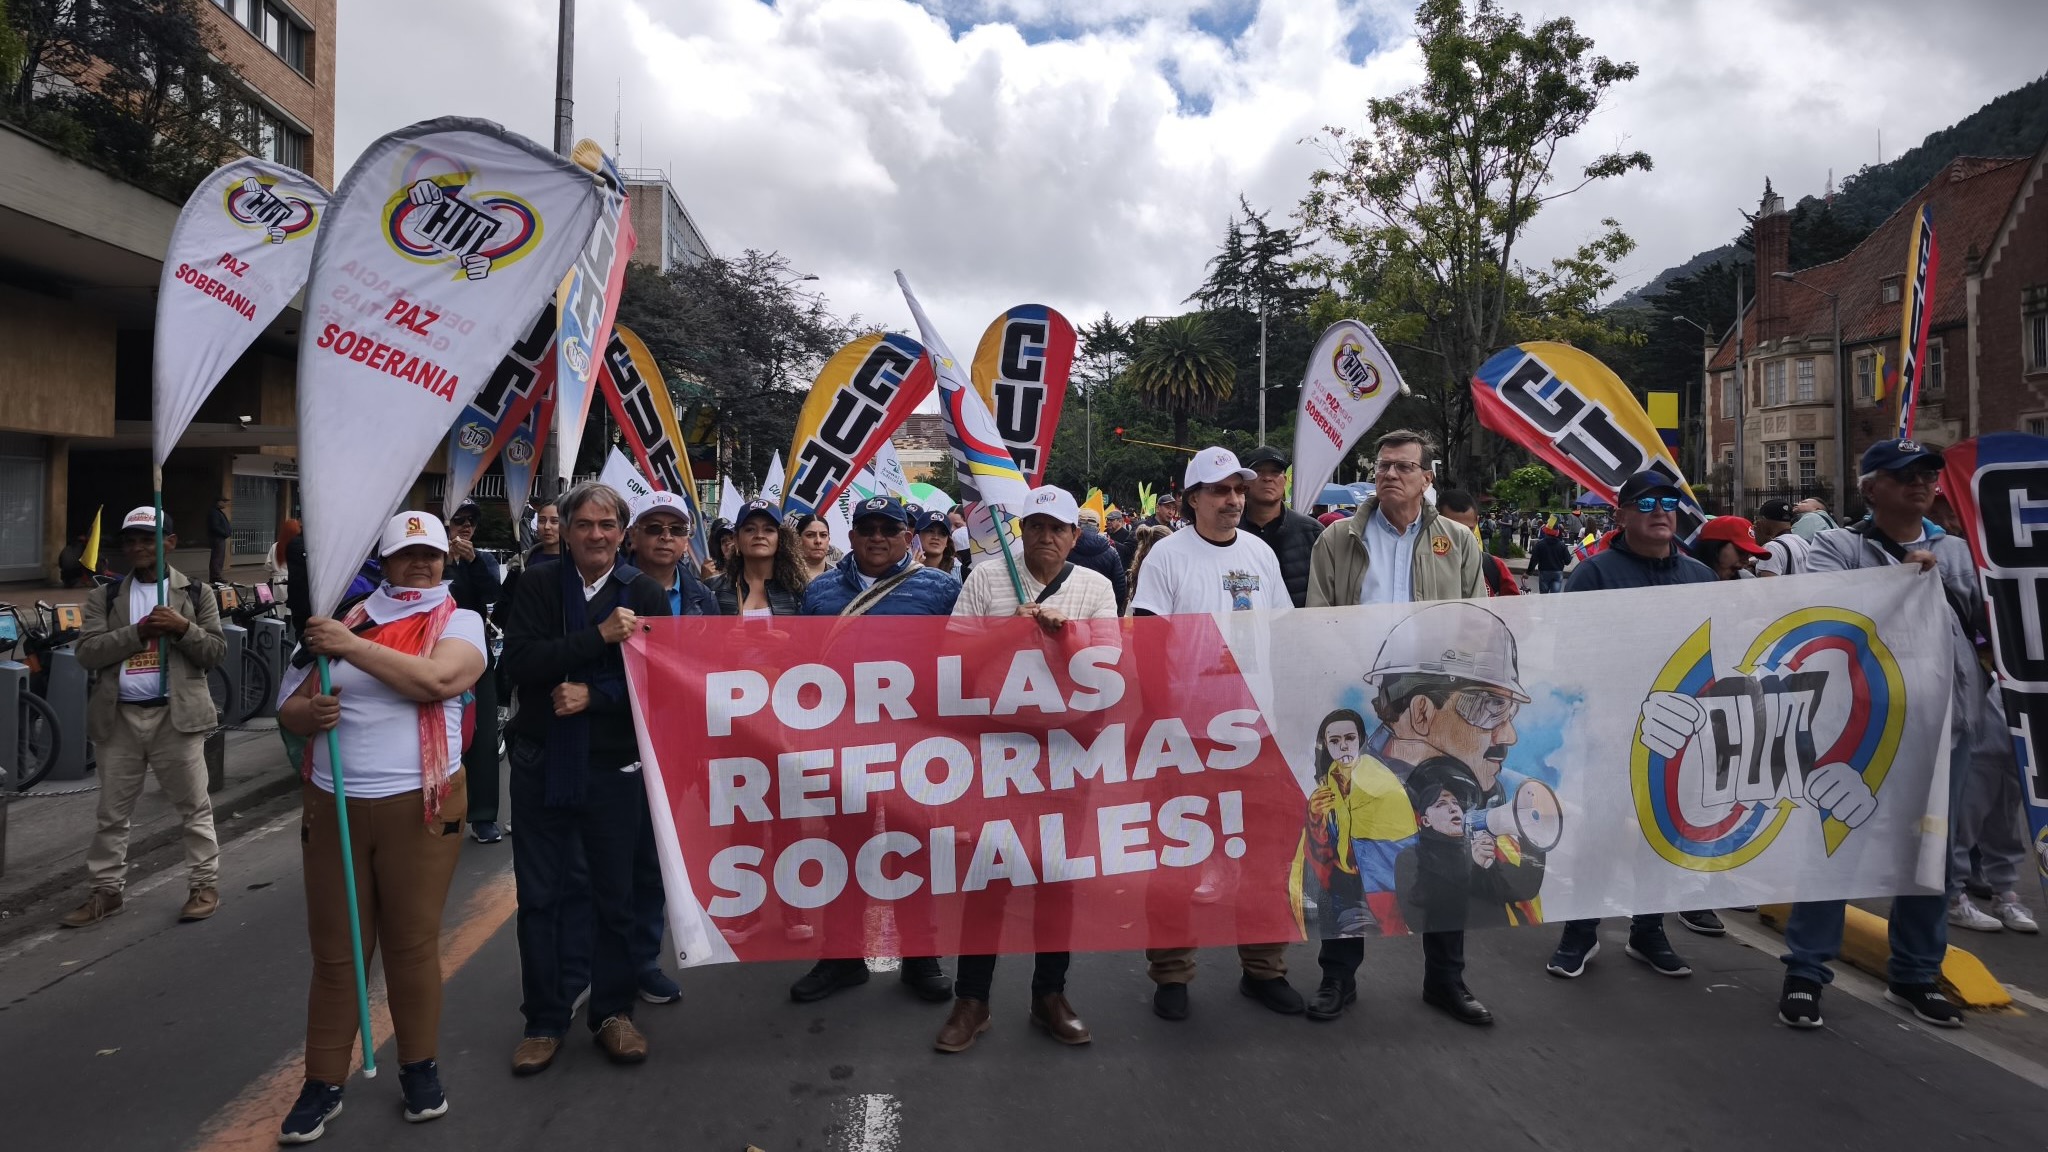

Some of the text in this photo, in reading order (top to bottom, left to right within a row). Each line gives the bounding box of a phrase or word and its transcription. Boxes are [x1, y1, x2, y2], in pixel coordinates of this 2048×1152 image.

[415, 197, 503, 262] CUT
[175, 263, 257, 322] SOBERANIA
[216, 252, 250, 278] PAZ
[384, 298, 441, 336] PAZ
[316, 323, 459, 402] SOBERANIA
[790, 342, 917, 505] CUT
[1304, 400, 1344, 451] SOBERANIA
[1326, 392, 1341, 413] PAZ
[627, 478, 650, 497] COM
[408, 517, 420, 530] SI
[705, 645, 1125, 737] POR LAS
[708, 708, 1261, 827] REFORMAS
[1700, 670, 1829, 808] CUT
[706, 789, 1247, 918] SOCIALES!
